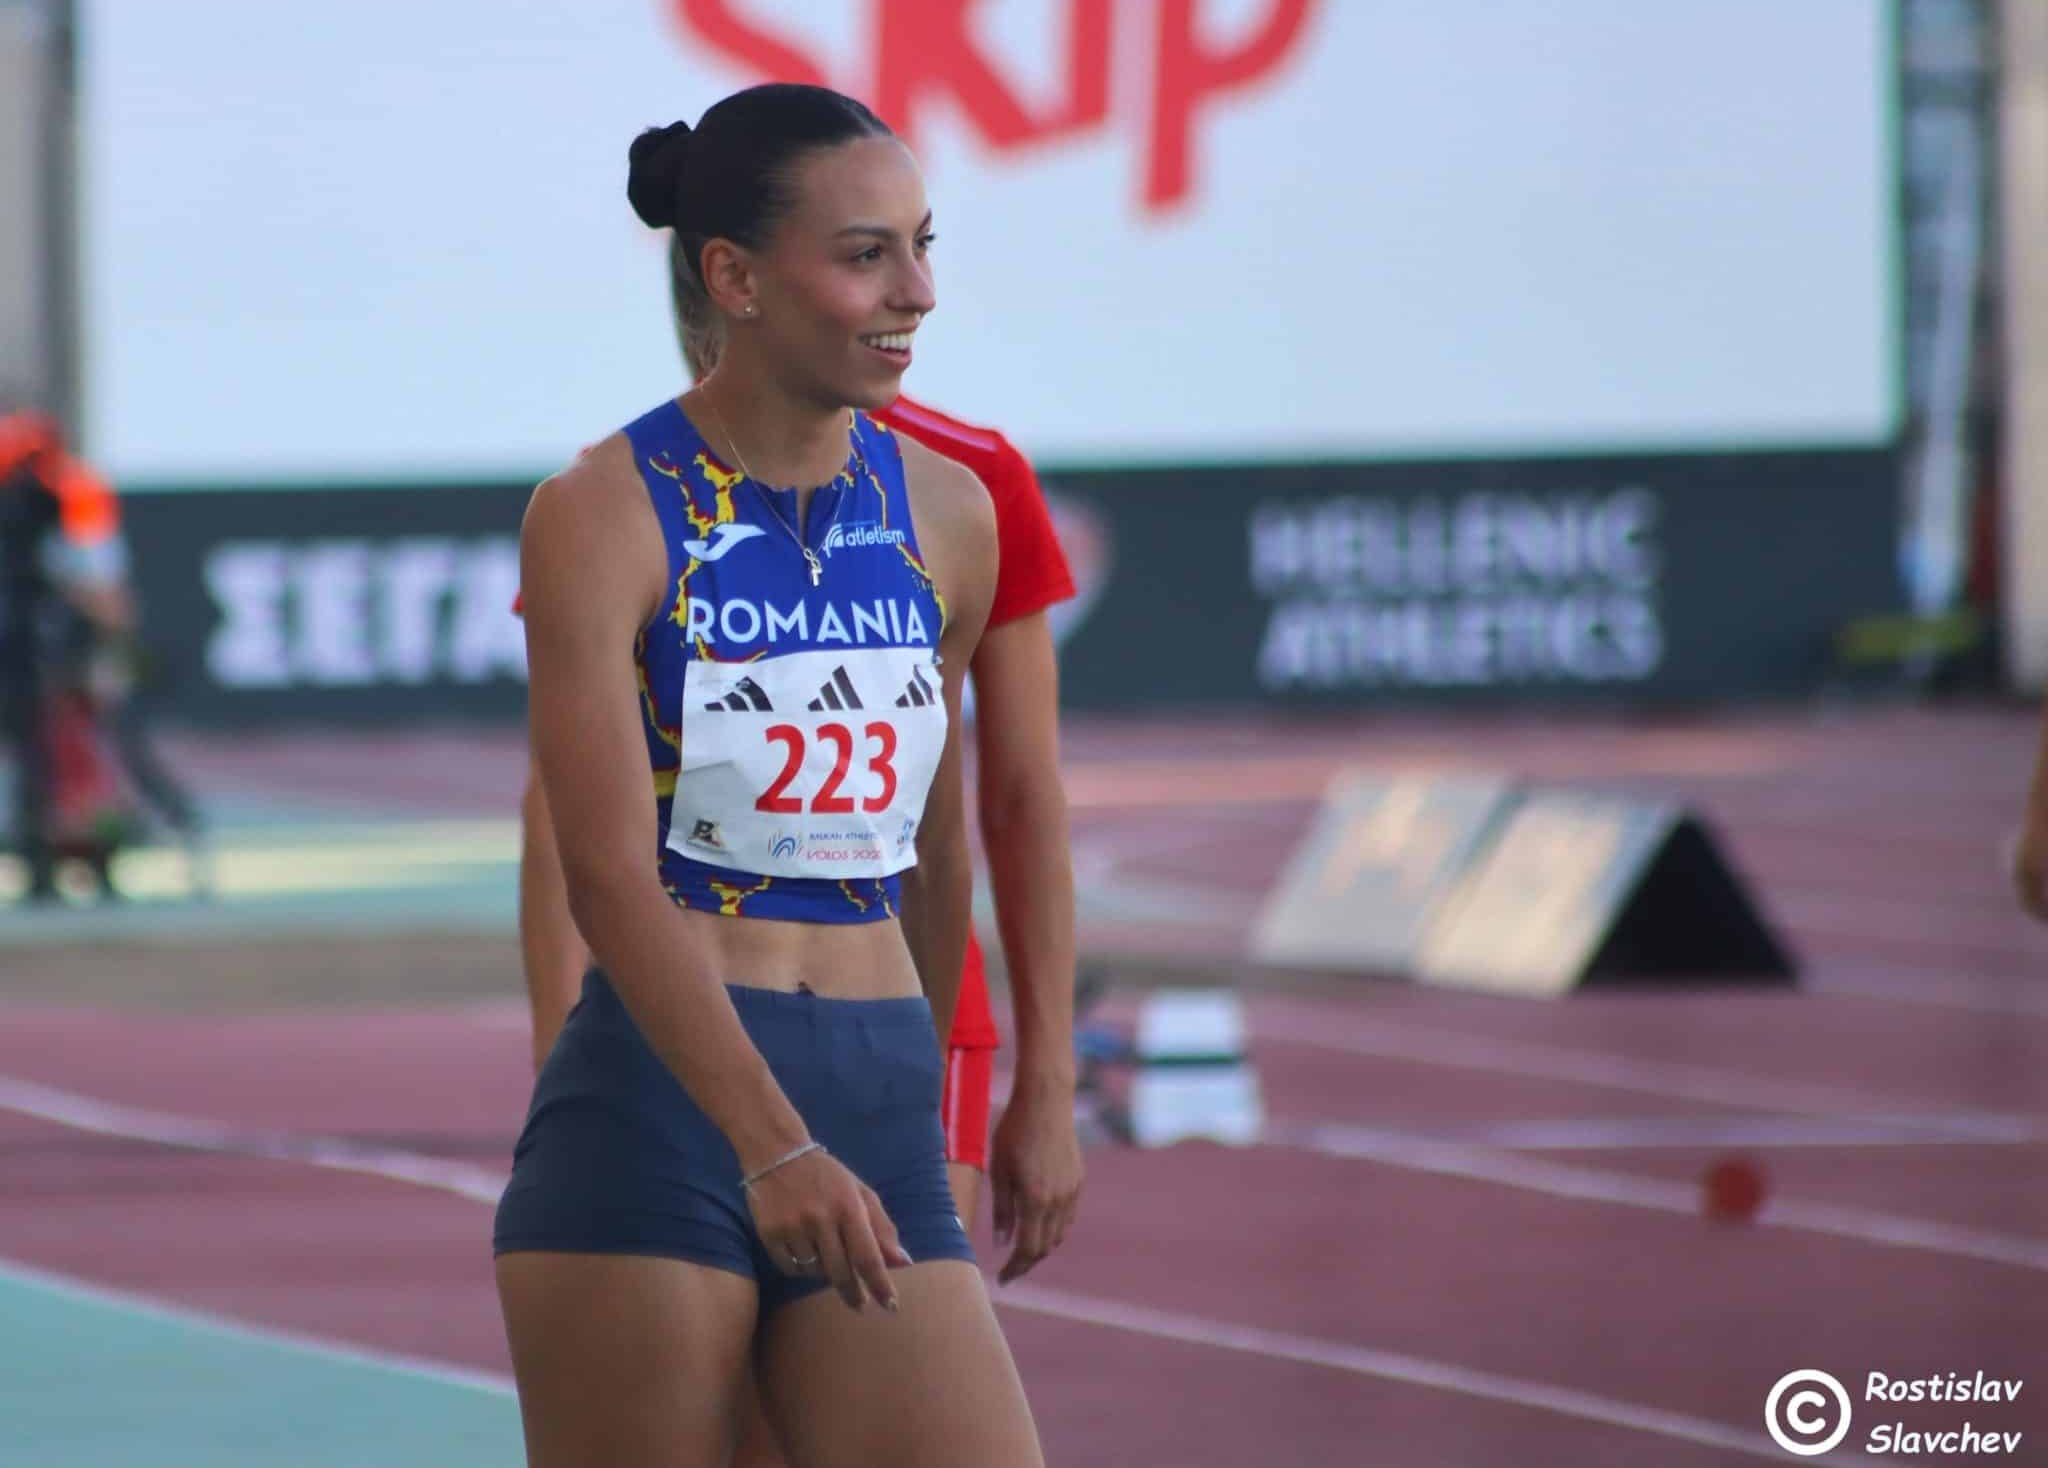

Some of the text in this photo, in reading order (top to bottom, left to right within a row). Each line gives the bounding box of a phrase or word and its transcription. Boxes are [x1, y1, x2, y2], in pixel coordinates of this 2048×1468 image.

[845, 525, 905, 547] atletism
[1250, 490, 1660, 590] HELLENIC
[686, 597, 928, 644] ROMANIA
[1258, 597, 1663, 685] ATHLETICS
[754, 721, 898, 814] 223
